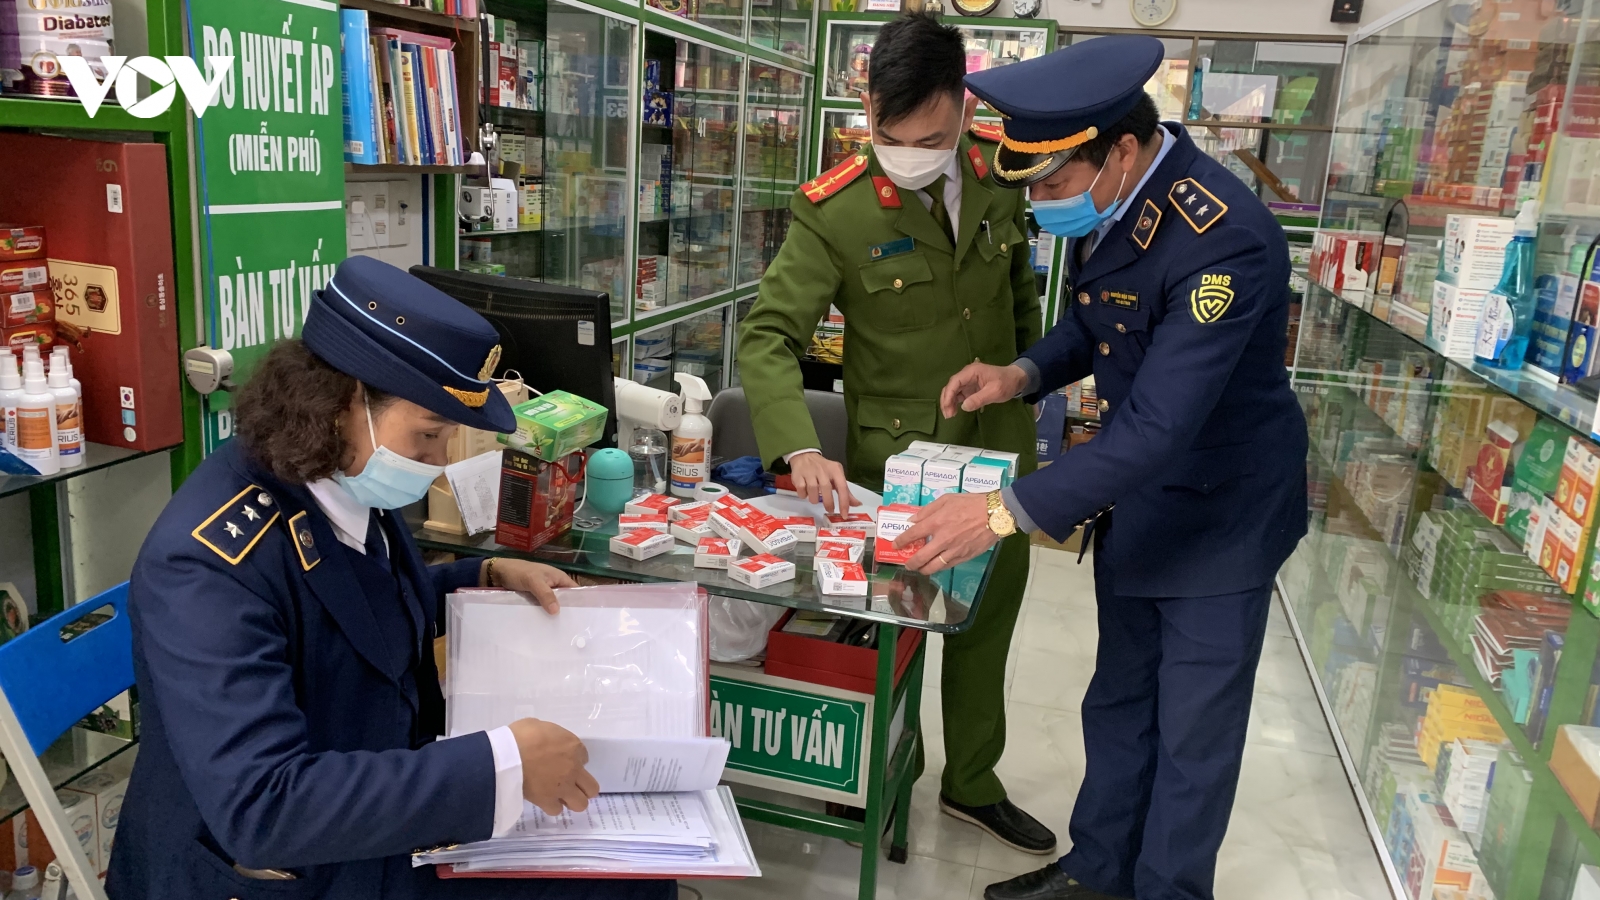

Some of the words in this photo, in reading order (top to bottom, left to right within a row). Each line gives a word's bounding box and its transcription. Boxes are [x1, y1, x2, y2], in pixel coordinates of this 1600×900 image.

[1019, 31, 1044, 48] 54
[240, 14, 304, 114] HUYẾT
[310, 27, 334, 115] ÁP
[228, 121, 283, 175] (MIỄN
[288, 130, 321, 176] PHÍ)
[1201, 274, 1232, 286] DMS
[63, 273, 81, 316] 365
[218, 256, 266, 351] BÀN
[269, 259, 295, 340] TƯ
[58, 433, 78, 442] RIUS
[672, 465, 699, 477] ERIUS
[886, 467, 919, 477] АРБИДОЛ
[924, 470, 958, 480] АРБИДОЛ
[964, 476, 999, 486] АРБИДОЛ
[881, 522, 910, 531] АРБИД
[710, 690, 743, 749] ÀN
[751, 707, 786, 756] TƯ
[791, 704, 845, 769] VẤN
